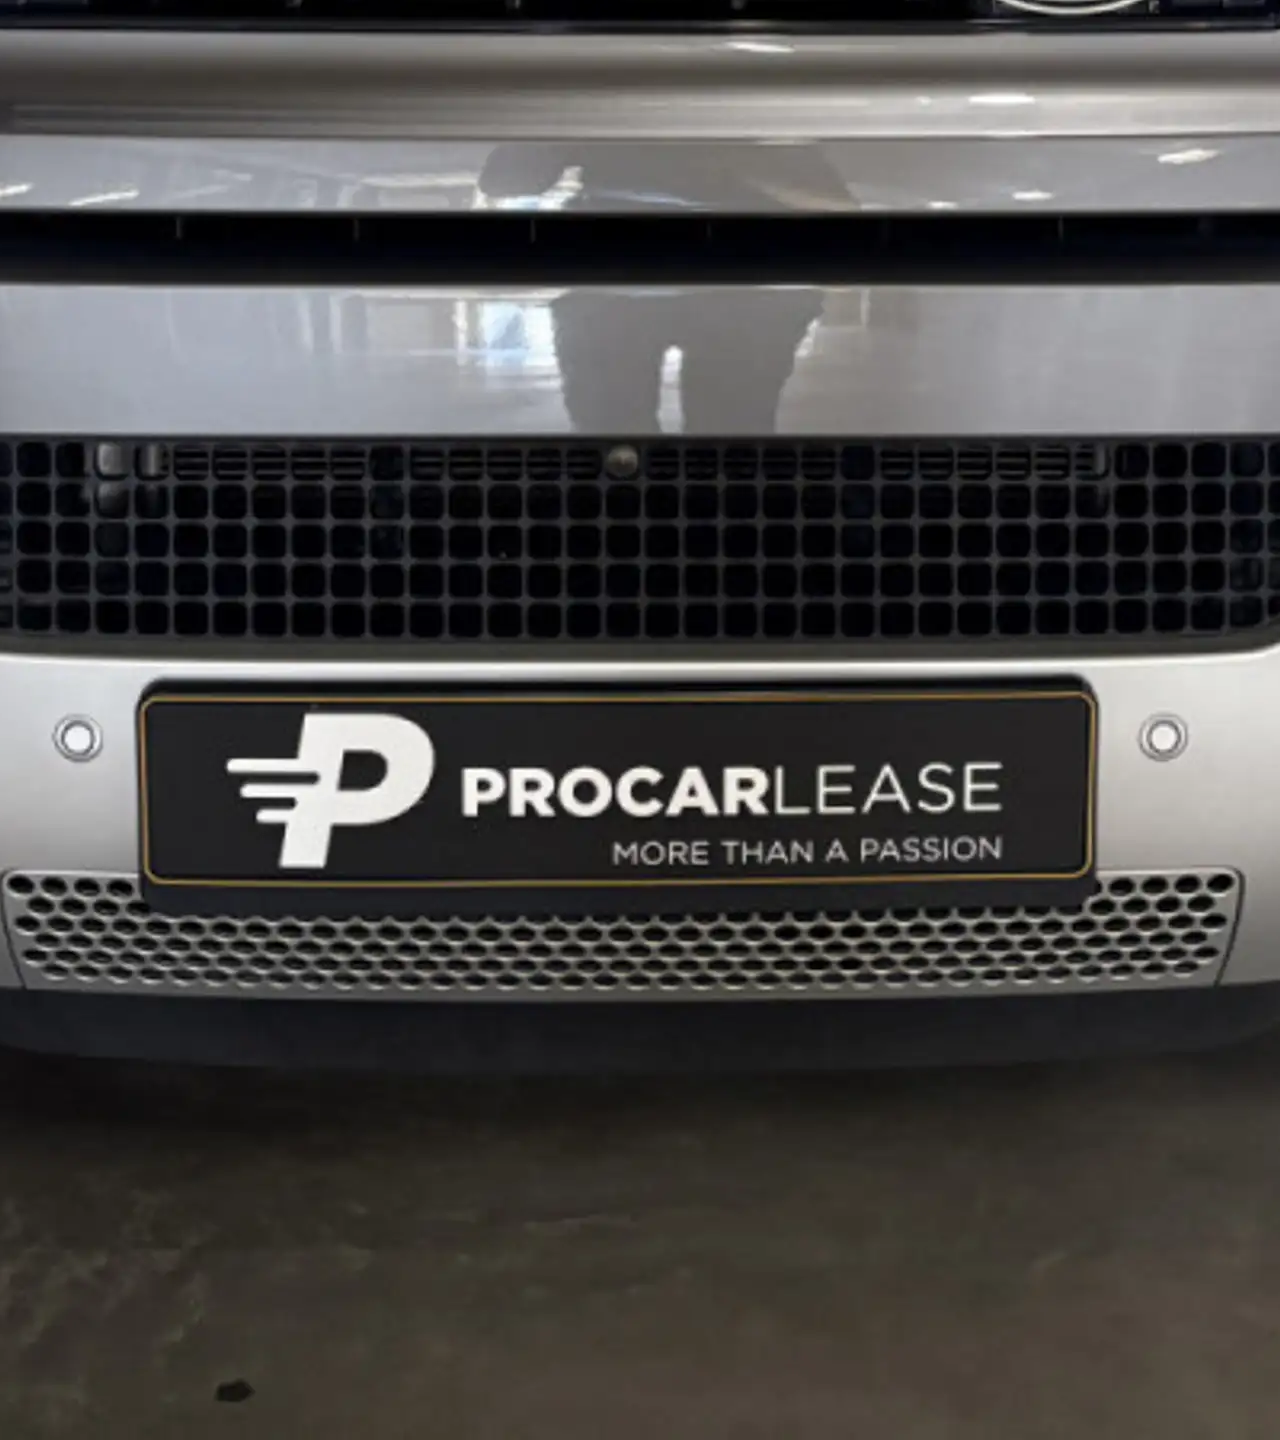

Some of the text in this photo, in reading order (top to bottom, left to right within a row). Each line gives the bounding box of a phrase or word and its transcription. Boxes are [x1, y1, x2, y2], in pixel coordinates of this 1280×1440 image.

[461, 762, 1004, 818] PROCARLEASE
[612, 836, 1002, 866] MORE THAN A PASSION
